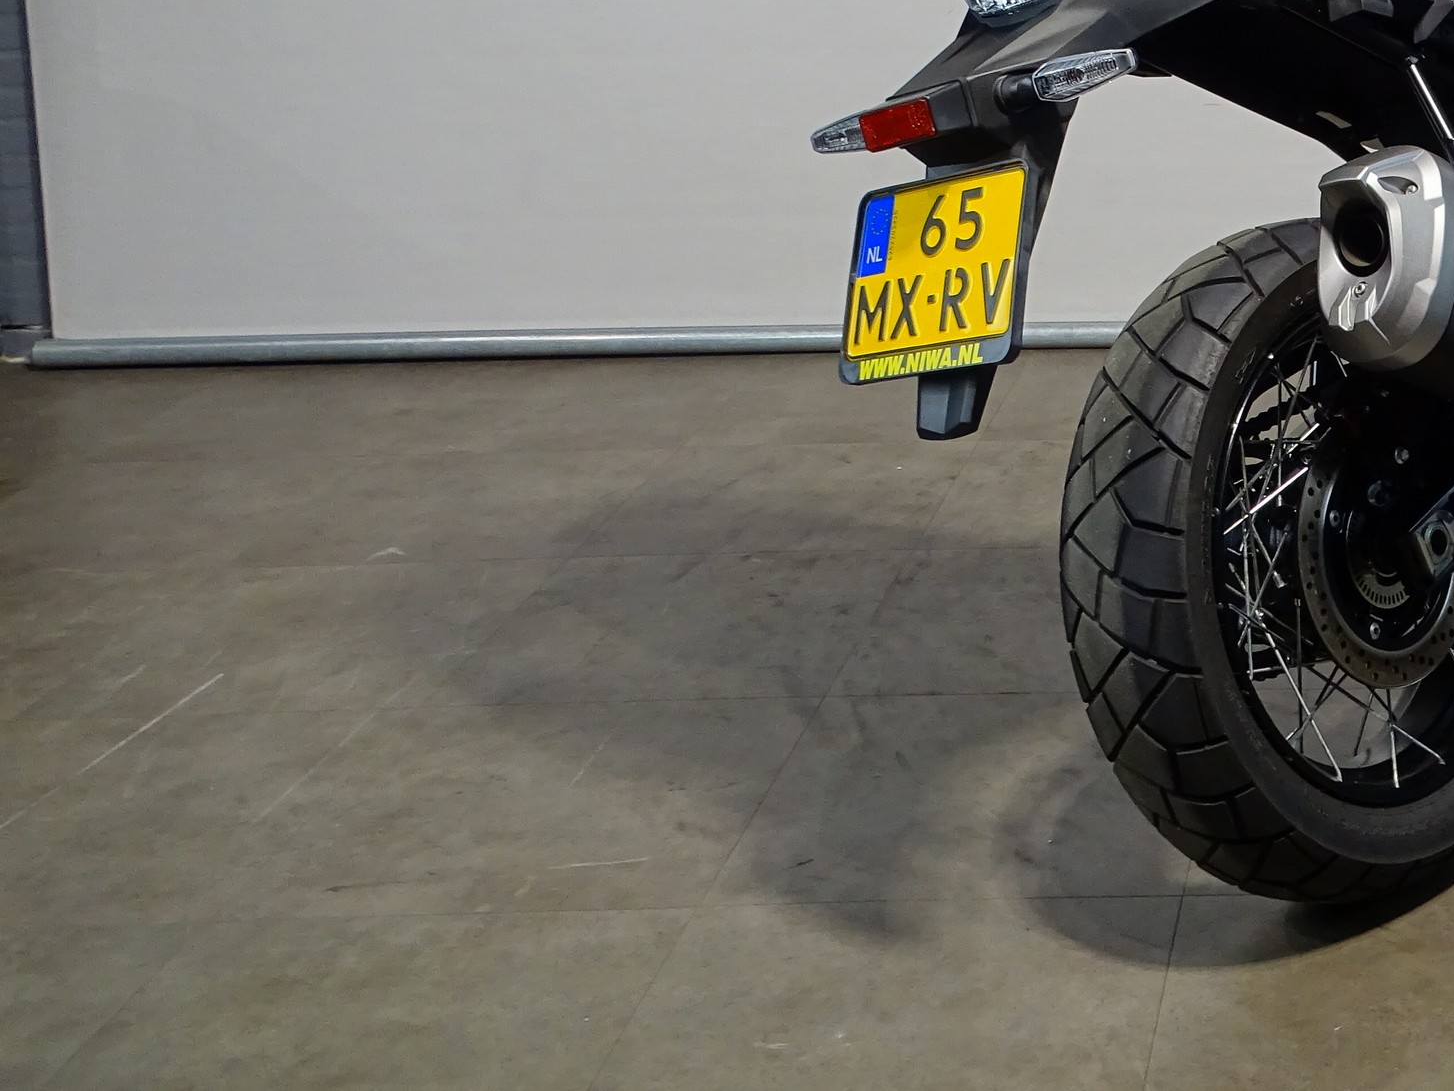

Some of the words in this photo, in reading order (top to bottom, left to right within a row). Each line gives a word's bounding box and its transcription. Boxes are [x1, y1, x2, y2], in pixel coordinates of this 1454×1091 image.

[920, 186, 984, 257] 65
[866, 245, 883, 265] NL
[858, 342, 983, 381] WWW.NIWA.NL
